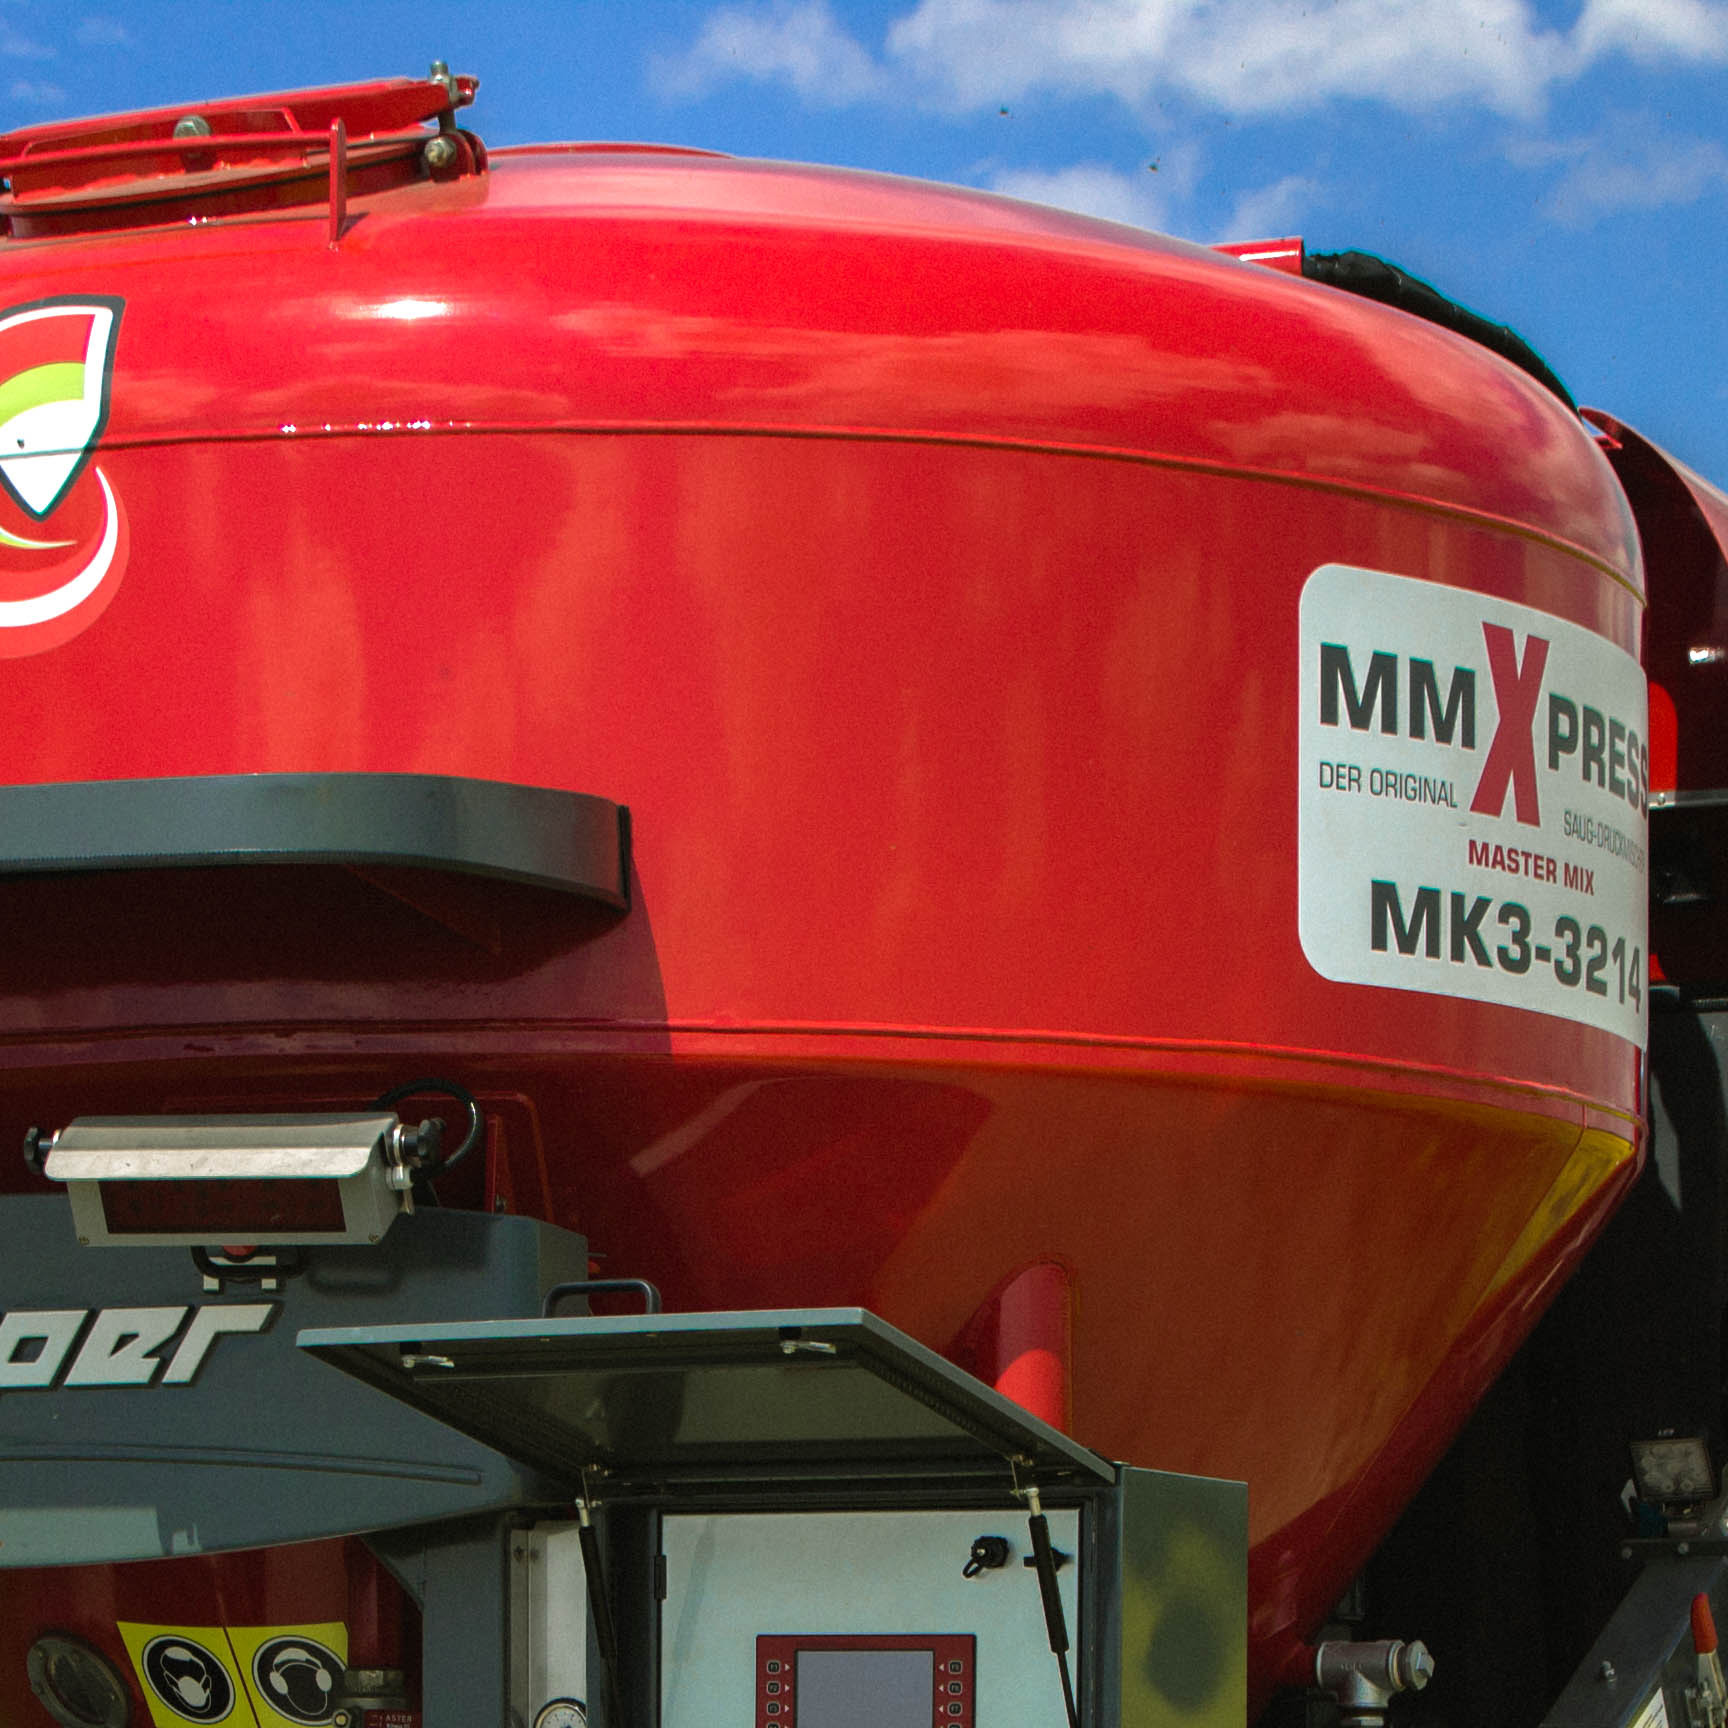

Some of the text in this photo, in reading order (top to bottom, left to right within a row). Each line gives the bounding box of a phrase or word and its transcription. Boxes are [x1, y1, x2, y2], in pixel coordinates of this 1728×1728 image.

[1319, 761, 1459, 808] DER ORIGINAL
[1468, 839, 1595, 896] MASTER MIX
[1370, 878, 1642, 1015] MK3-3214
